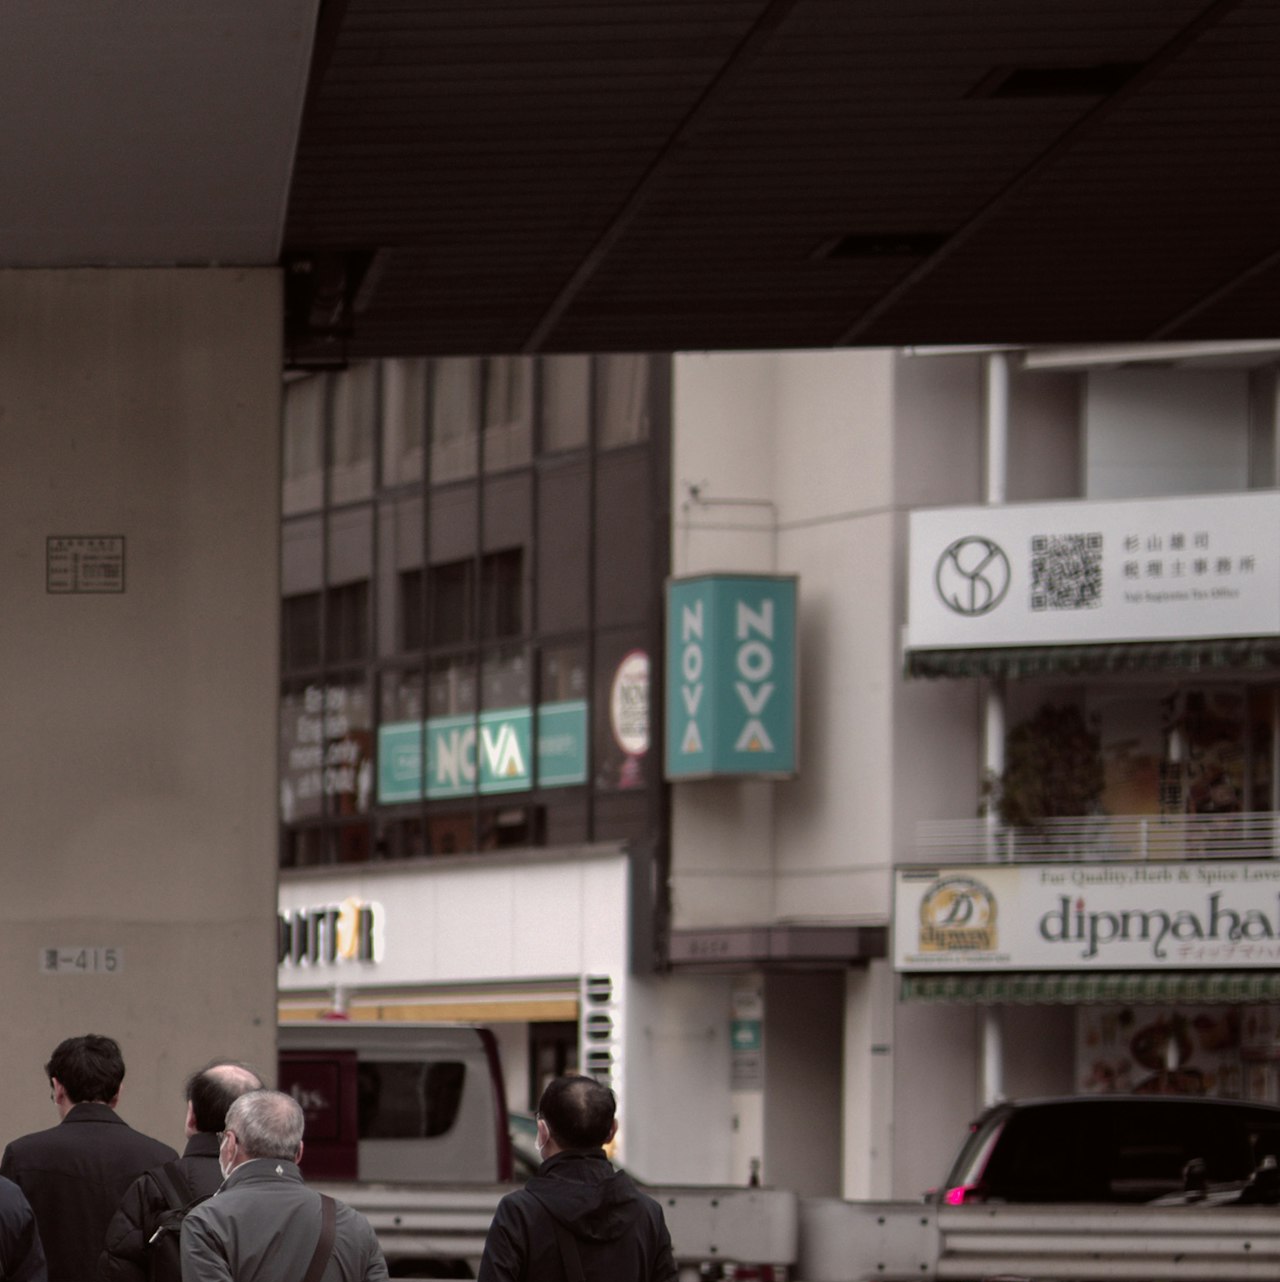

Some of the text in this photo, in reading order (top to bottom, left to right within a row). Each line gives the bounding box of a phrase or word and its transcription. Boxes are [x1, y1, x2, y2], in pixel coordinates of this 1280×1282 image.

[1123, 555, 1255, 579] 税理士事務所
[682, 599, 704, 752] NOVA
[735, 599, 774, 752] NOVA
[436, 722, 526, 790] NOVA
[1197, 866, 1240, 885] Spice
[1040, 891, 1280, 958] dipmaha
